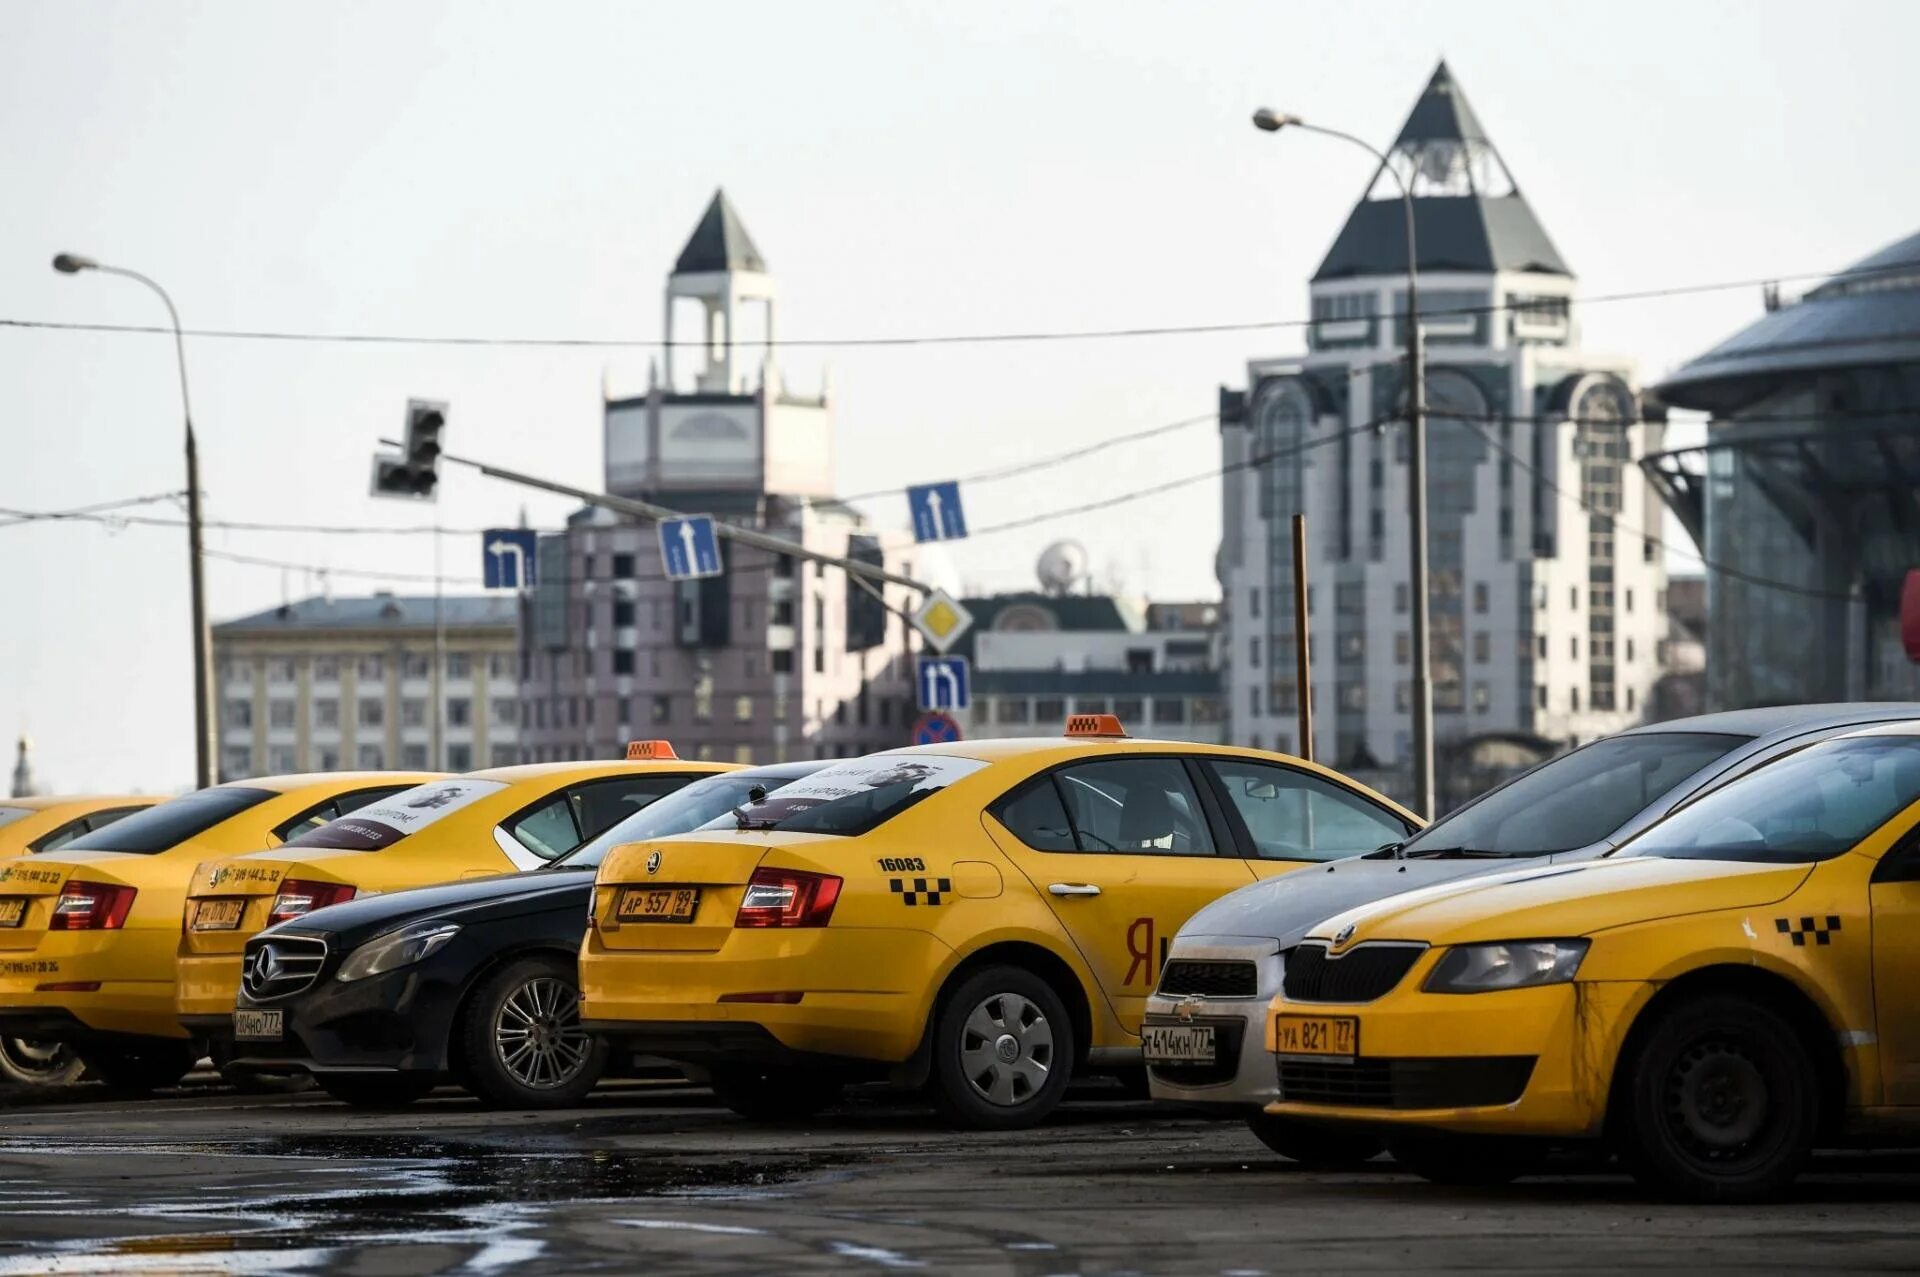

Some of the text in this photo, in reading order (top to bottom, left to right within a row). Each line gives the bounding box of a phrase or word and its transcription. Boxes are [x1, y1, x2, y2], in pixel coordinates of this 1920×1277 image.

[877, 857, 926, 871] 16083
[269, 870, 279, 882] 32
[624, 891, 691, 913] АР 557 99
[263, 1012, 280, 1028] 777
[1146, 1028, 1210, 1055] Т414КН 777
[1283, 1021, 1350, 1050] УА 821 77
